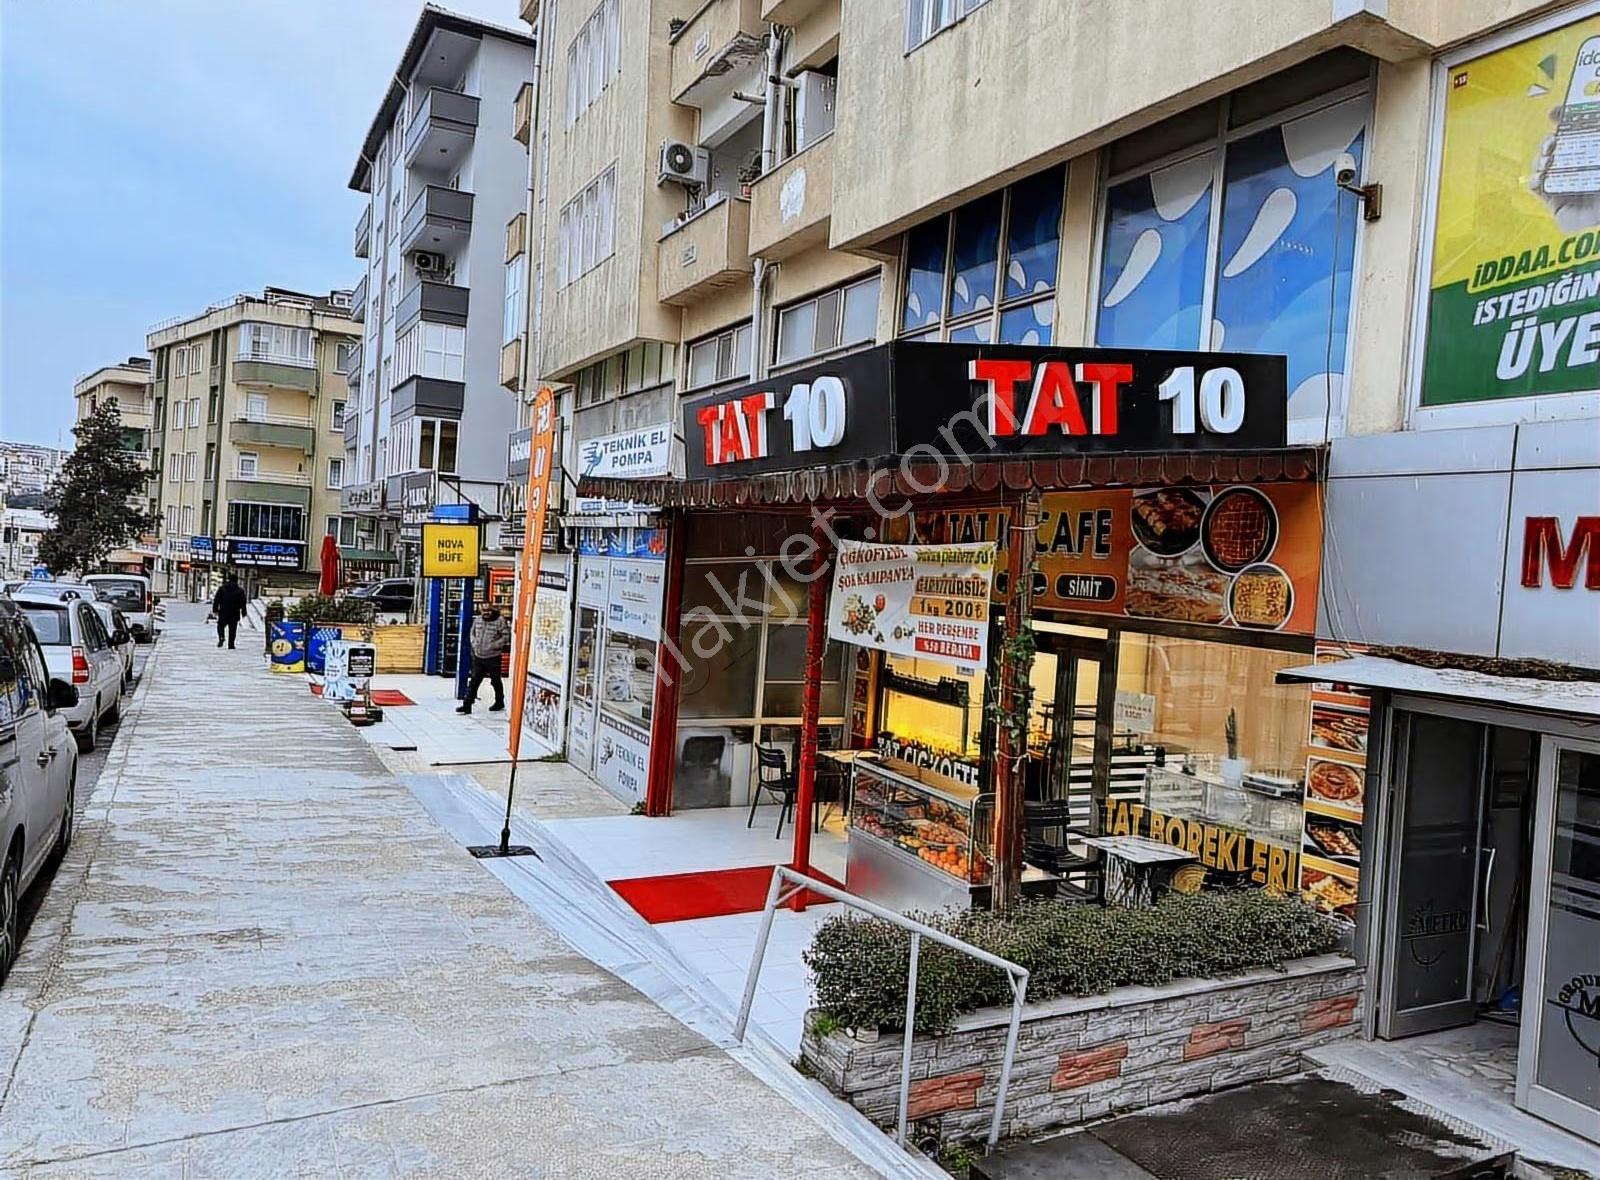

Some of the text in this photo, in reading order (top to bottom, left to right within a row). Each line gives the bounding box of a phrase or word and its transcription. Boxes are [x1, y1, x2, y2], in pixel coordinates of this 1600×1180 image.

[969, 359, 1246, 436] TAT 10
[697, 375, 845, 466] TAT 10
[603, 430, 667, 454] TEKNİK EL
[611, 450, 652, 468] POMPA
[949, 512, 989, 543] TAT
[1035, 508, 1114, 554] CAFE
[437, 539, 464, 549] NOVA
[438, 551, 463, 562] BÜFE
[1068, 576, 1102, 598] SİMİT
[918, 621, 980, 640] HER PERŞEMBE
[1106, 797, 1145, 836] TAT
